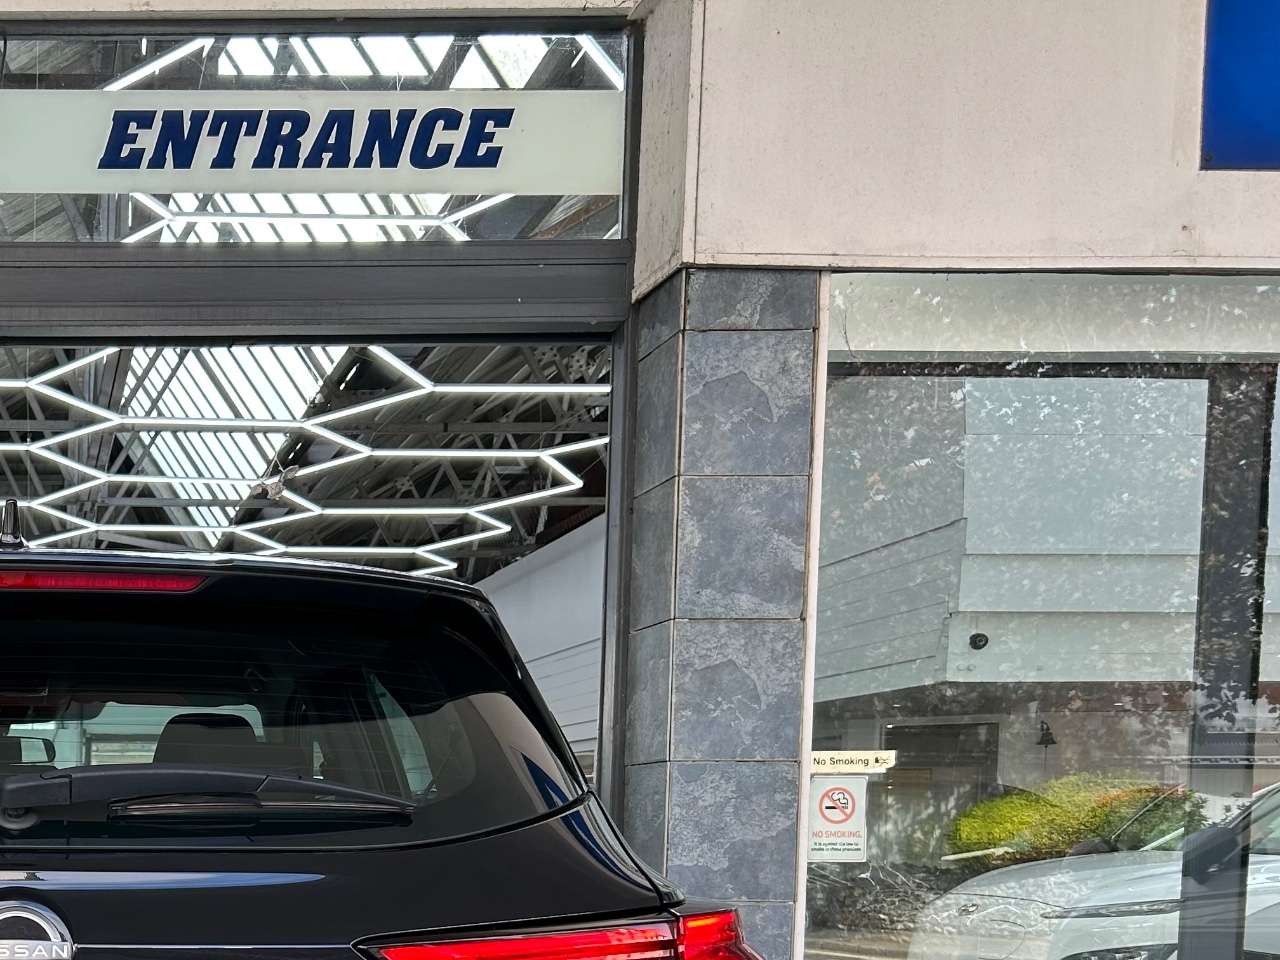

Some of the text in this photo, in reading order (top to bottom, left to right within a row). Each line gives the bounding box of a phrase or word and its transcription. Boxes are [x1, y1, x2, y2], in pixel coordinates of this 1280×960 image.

[97, 107, 515, 170] ENTRANCE
[813, 757, 869, 767] No Smoking
[812, 830, 823, 838] NO
